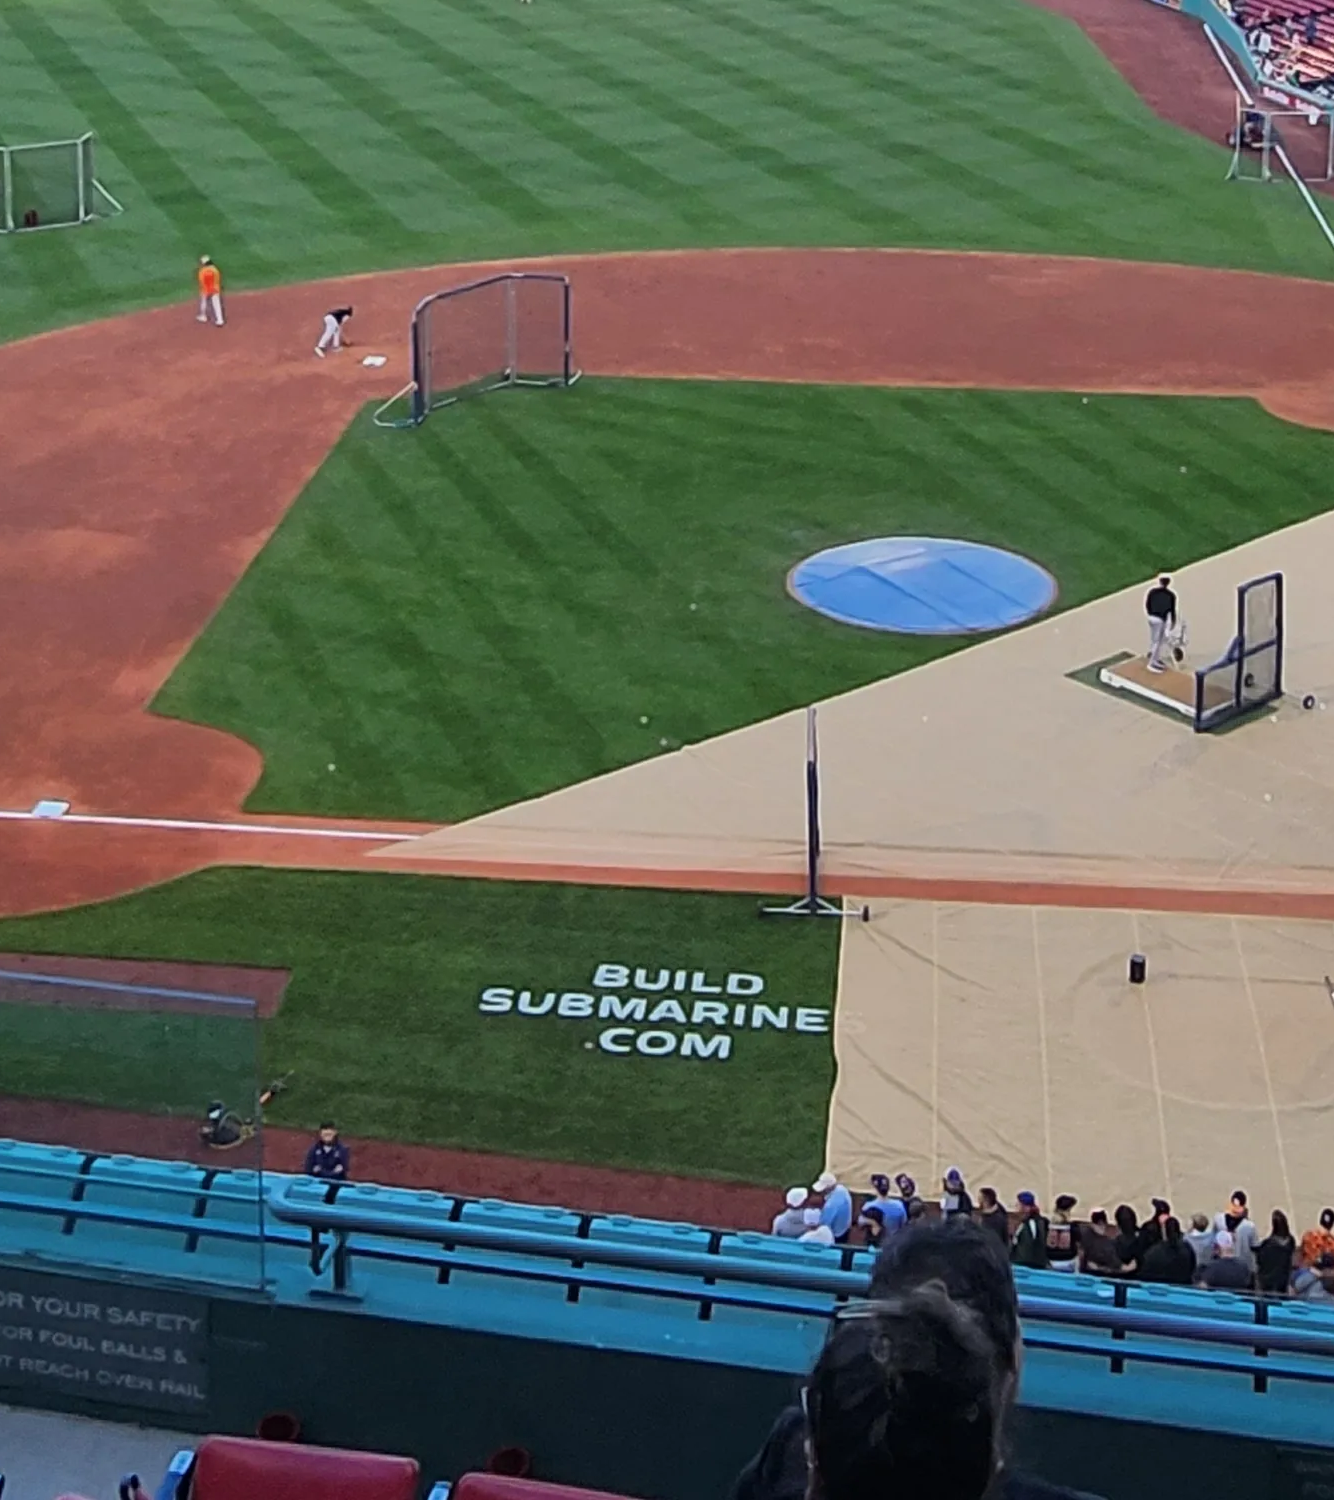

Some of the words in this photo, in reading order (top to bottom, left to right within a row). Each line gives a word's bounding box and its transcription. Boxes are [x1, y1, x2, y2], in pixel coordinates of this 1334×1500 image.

[593, 963, 765, 996] BUILD
[478, 987, 831, 1033] SUBMARINE
[584, 1027, 733, 1059] .COM
[31, 1295, 102, 1322] YOUR
[106, 1305, 203, 1334] SAFETY
[38, 1329, 95, 1353] FOUL
[100, 1339, 167, 1364] BALLS
[172, 1348, 188, 1365] &
[19, 1357, 90, 1384] REACH
[95, 1369, 155, 1393] OVER
[159, 1378, 206, 1400] RAIL
